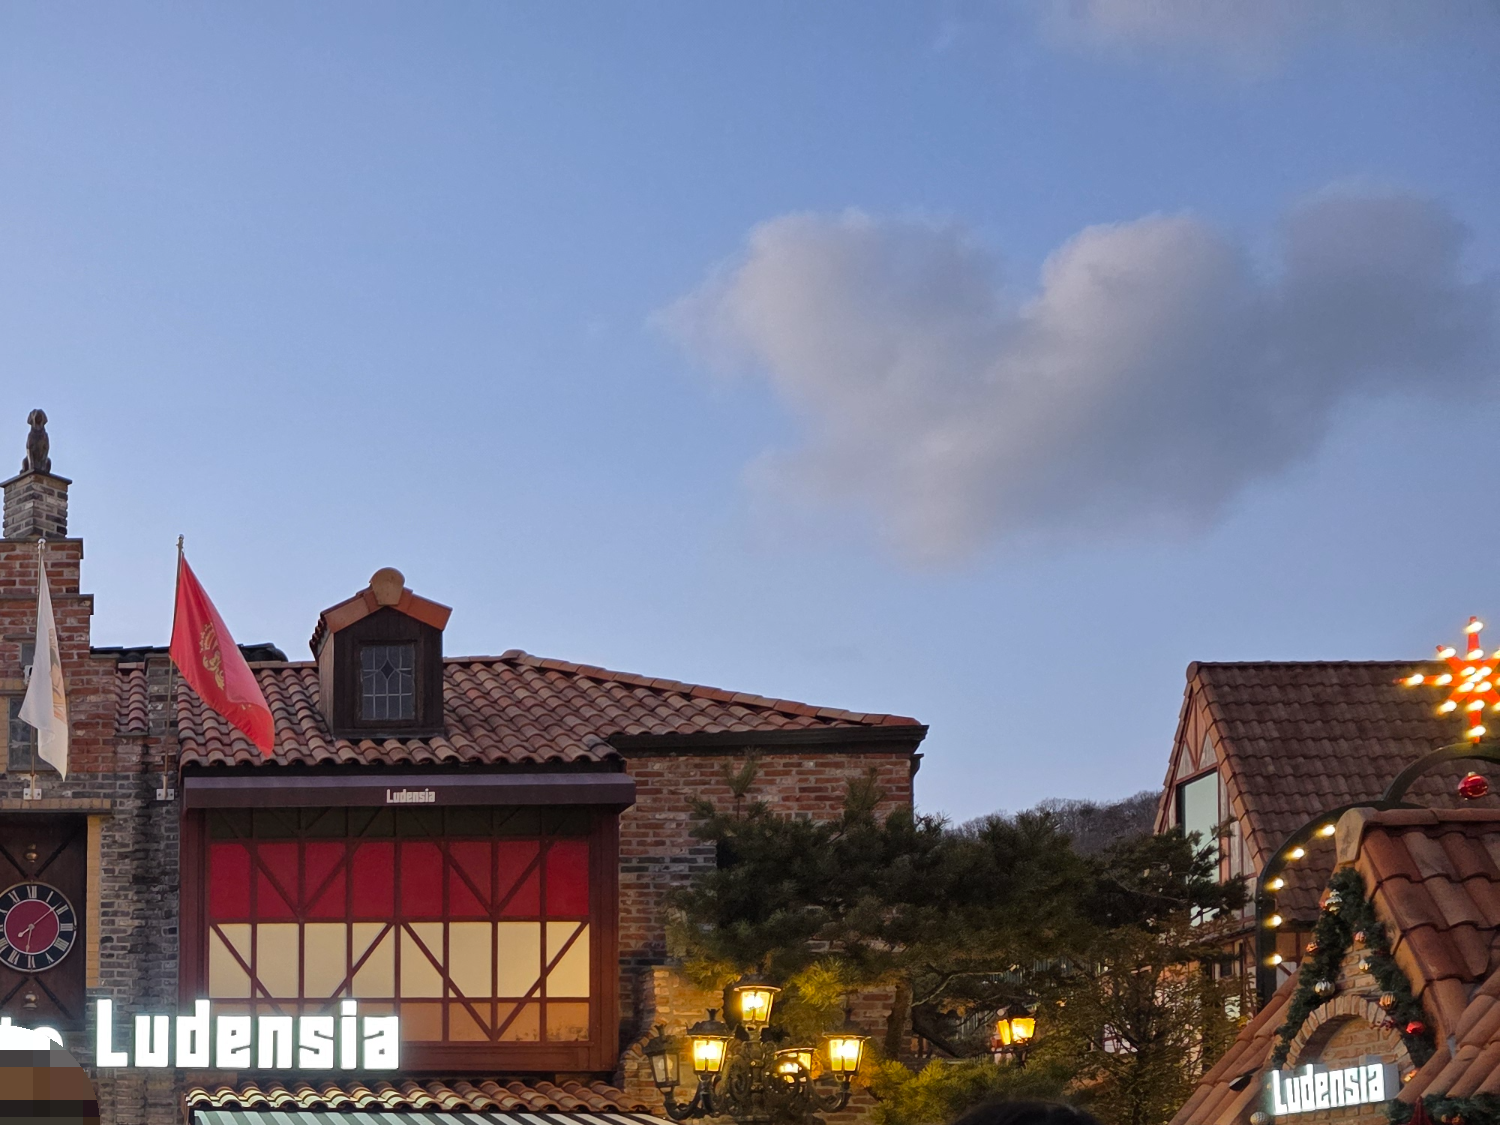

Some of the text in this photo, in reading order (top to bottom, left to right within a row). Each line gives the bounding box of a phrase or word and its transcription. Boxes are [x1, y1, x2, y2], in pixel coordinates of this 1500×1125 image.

[386, 787, 436, 804] Ludensia
[96, 998, 399, 1070] Ludensia
[1271, 1062, 1386, 1116] Ludensia
